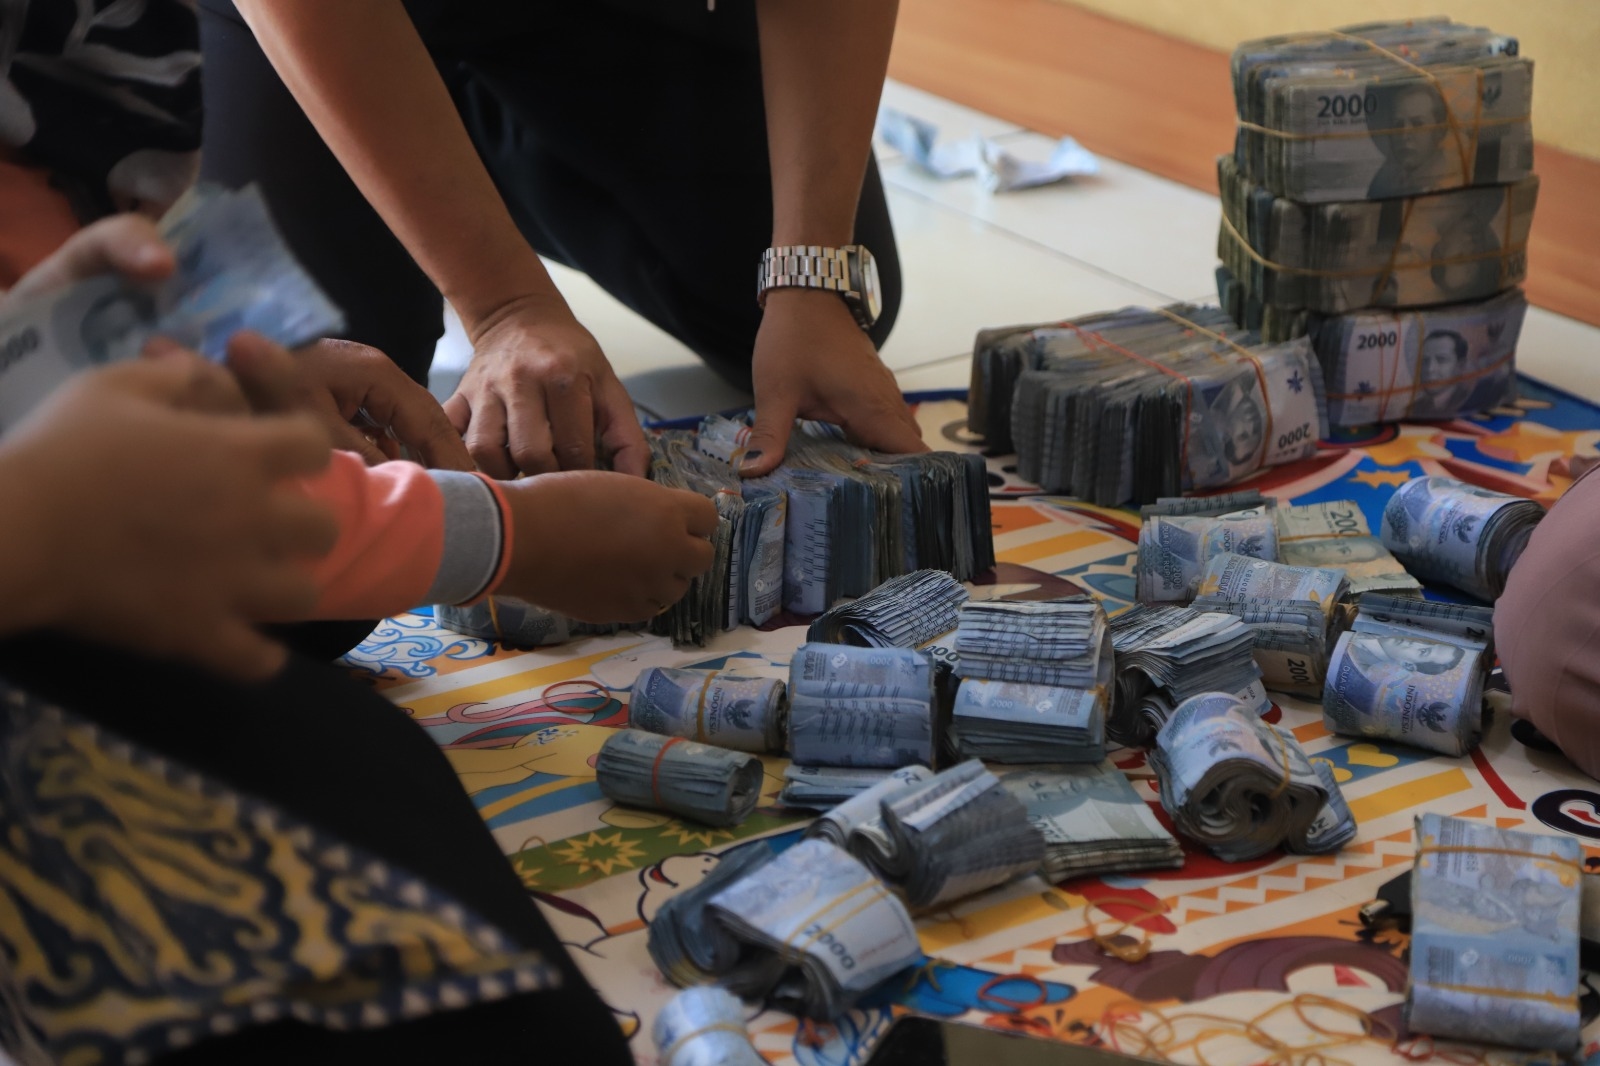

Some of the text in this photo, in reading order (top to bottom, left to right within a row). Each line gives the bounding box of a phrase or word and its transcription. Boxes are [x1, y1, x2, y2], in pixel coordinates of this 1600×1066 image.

[1317, 93, 1377, 118] 2000
[1357, 331, 1398, 350] 2000
[1278, 422, 1310, 449] 2000
[1162, 540, 1170, 558] RIBU
[1173, 567, 1182, 590] 2000
[651, 676, 661, 690] DUA
[1340, 665, 1351, 684] DUA
[709, 686, 722, 736] INDONESIA
[991, 699, 1013, 709] 2000
[1401, 684, 1416, 734] INDONESIA
